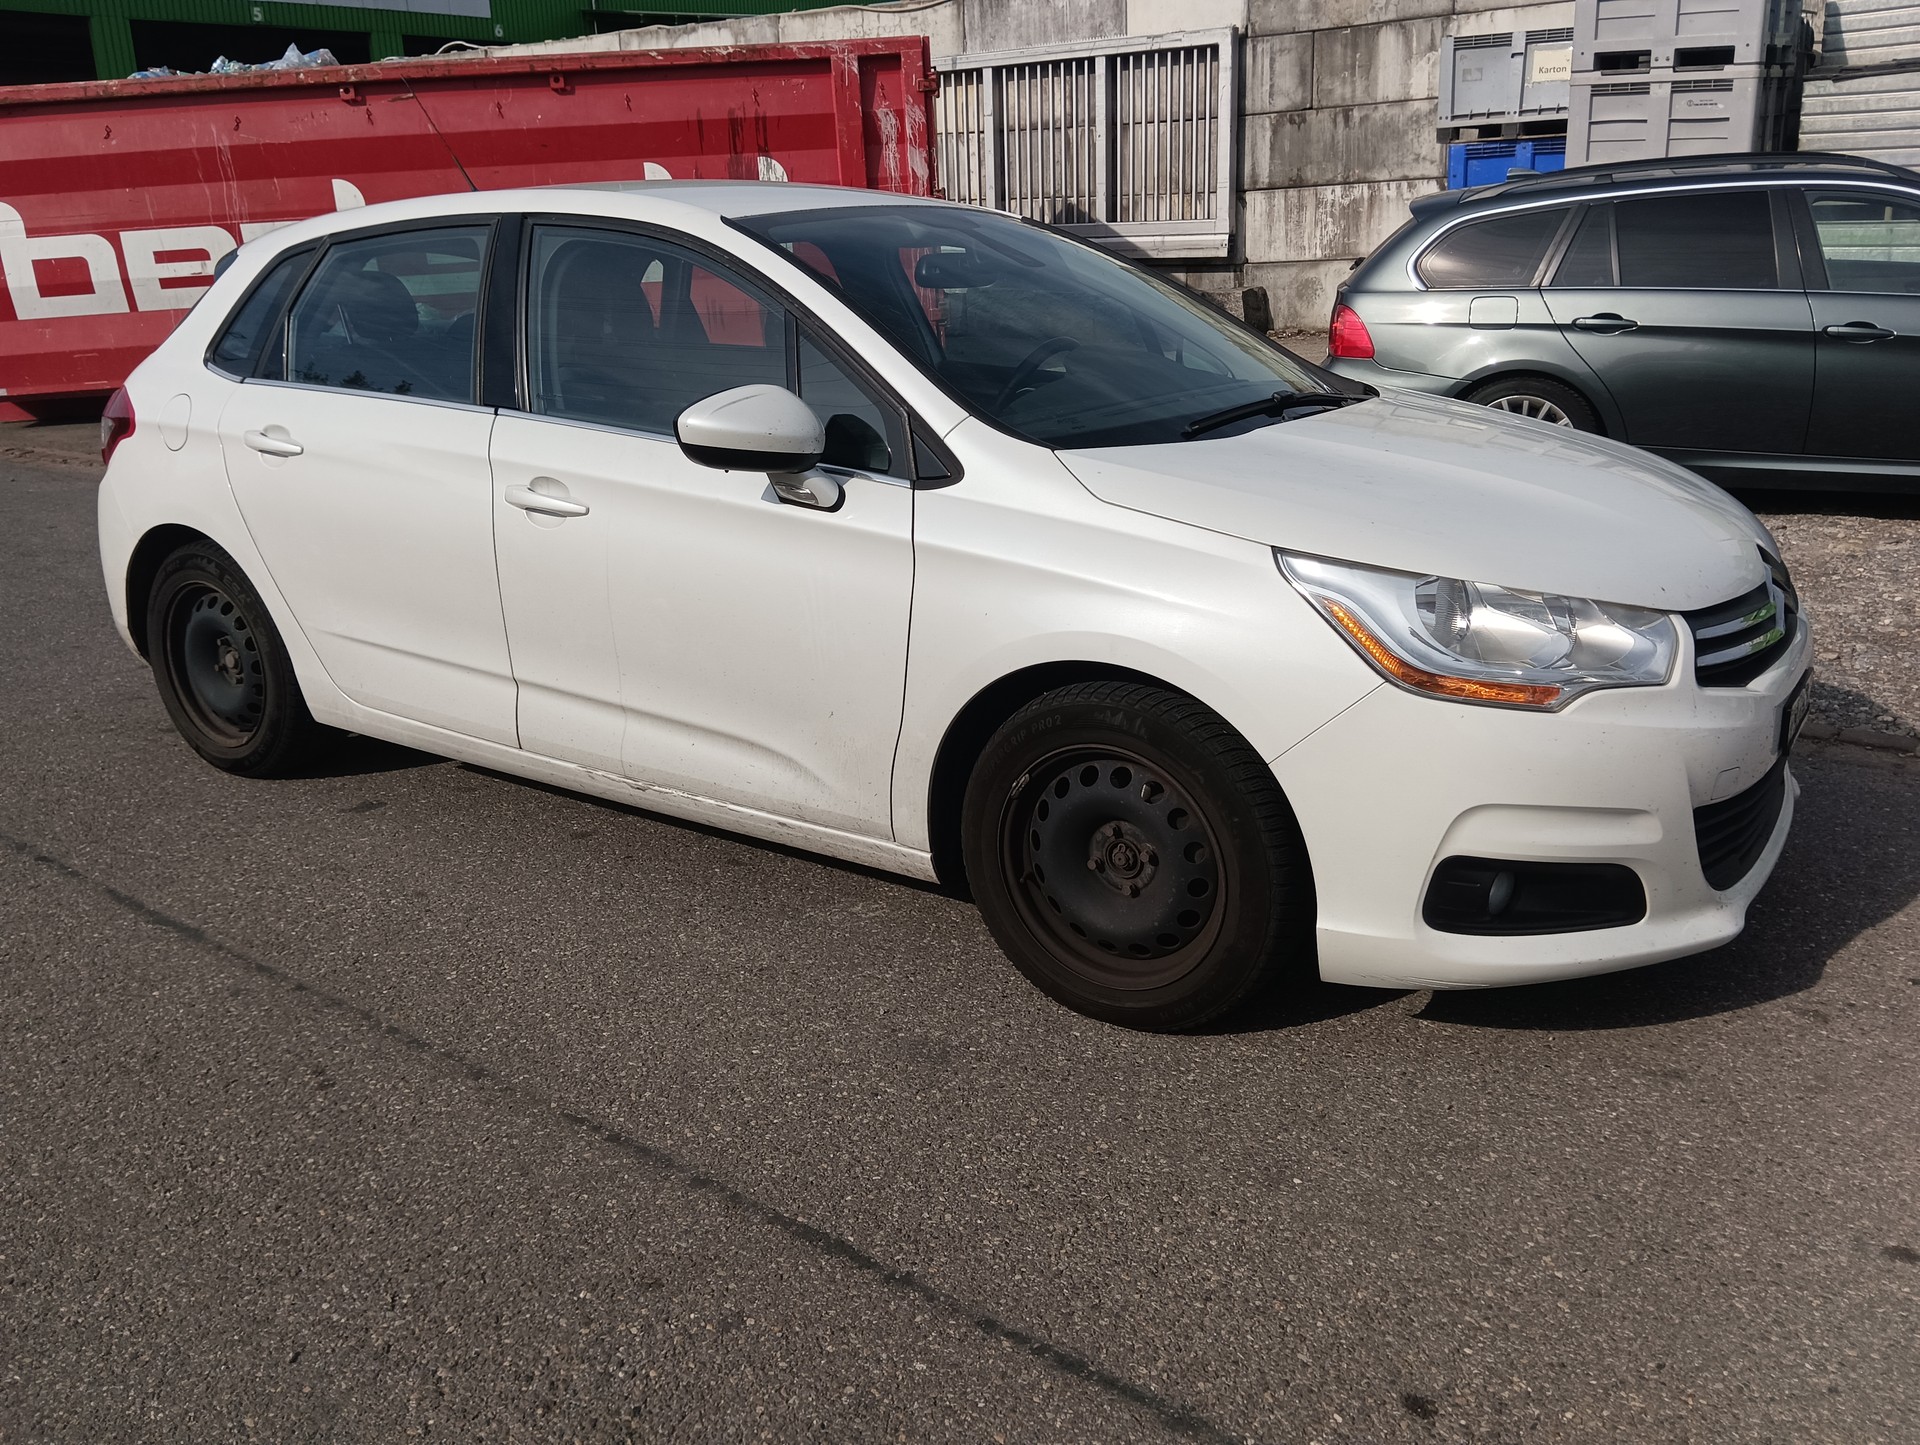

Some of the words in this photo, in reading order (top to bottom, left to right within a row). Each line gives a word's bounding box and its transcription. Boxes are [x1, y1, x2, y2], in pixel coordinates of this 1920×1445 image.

[253, 6, 263, 22] 5
[494, 24, 504, 38] 6
[1538, 66, 1567, 74] Karton
